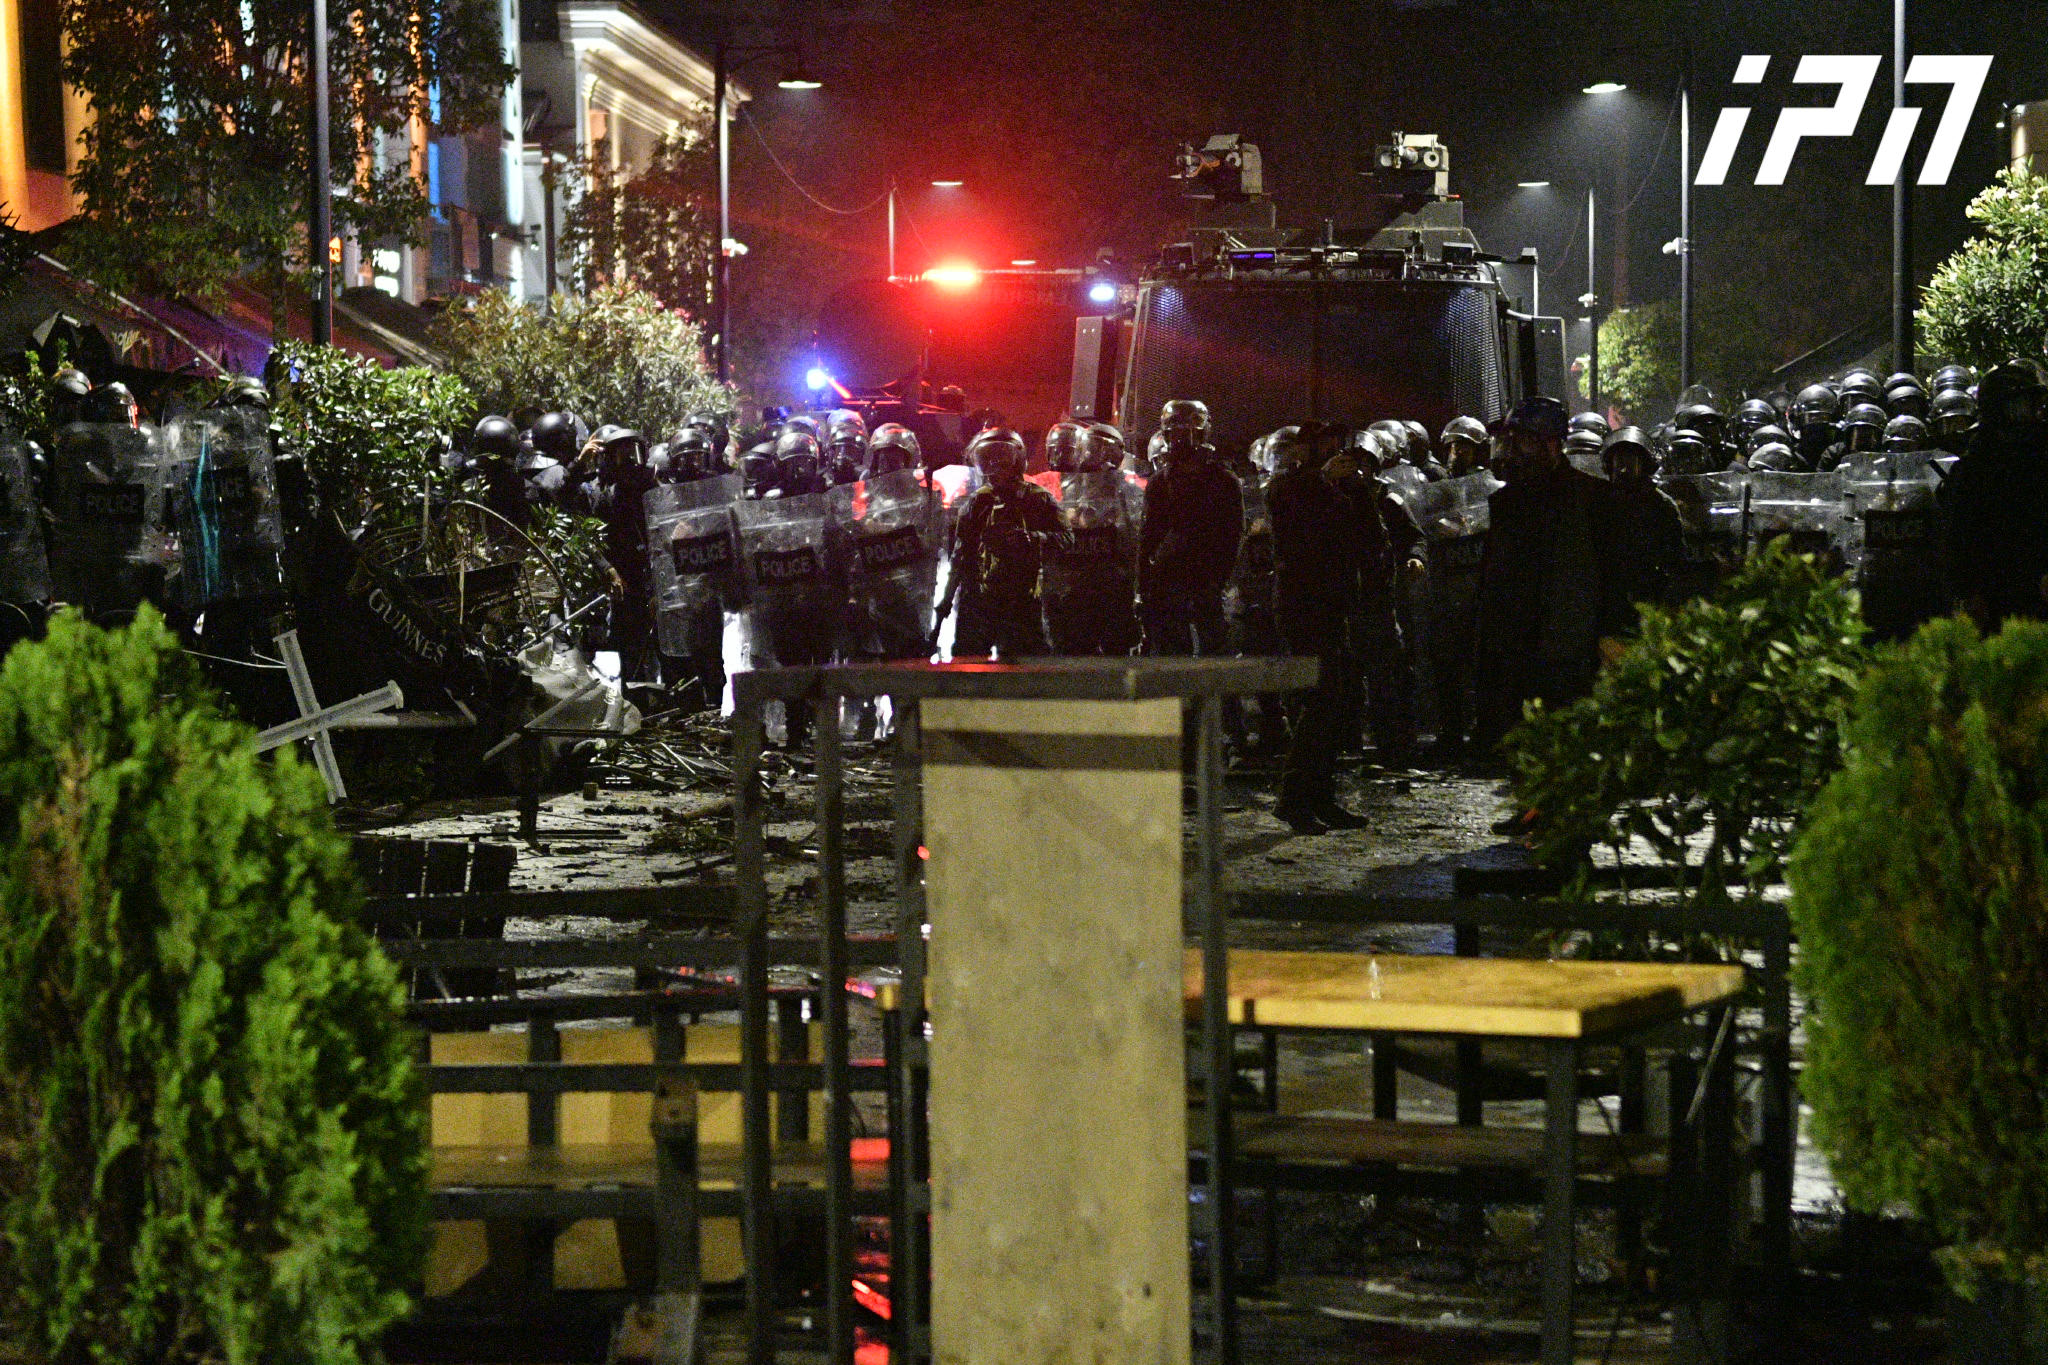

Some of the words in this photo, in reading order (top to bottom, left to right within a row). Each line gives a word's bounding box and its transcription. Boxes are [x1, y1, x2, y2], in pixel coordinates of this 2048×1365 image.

[677, 540, 728, 567] POLICE
[863, 535, 917, 565] POLICE
[760, 555, 811, 578] POLICE
